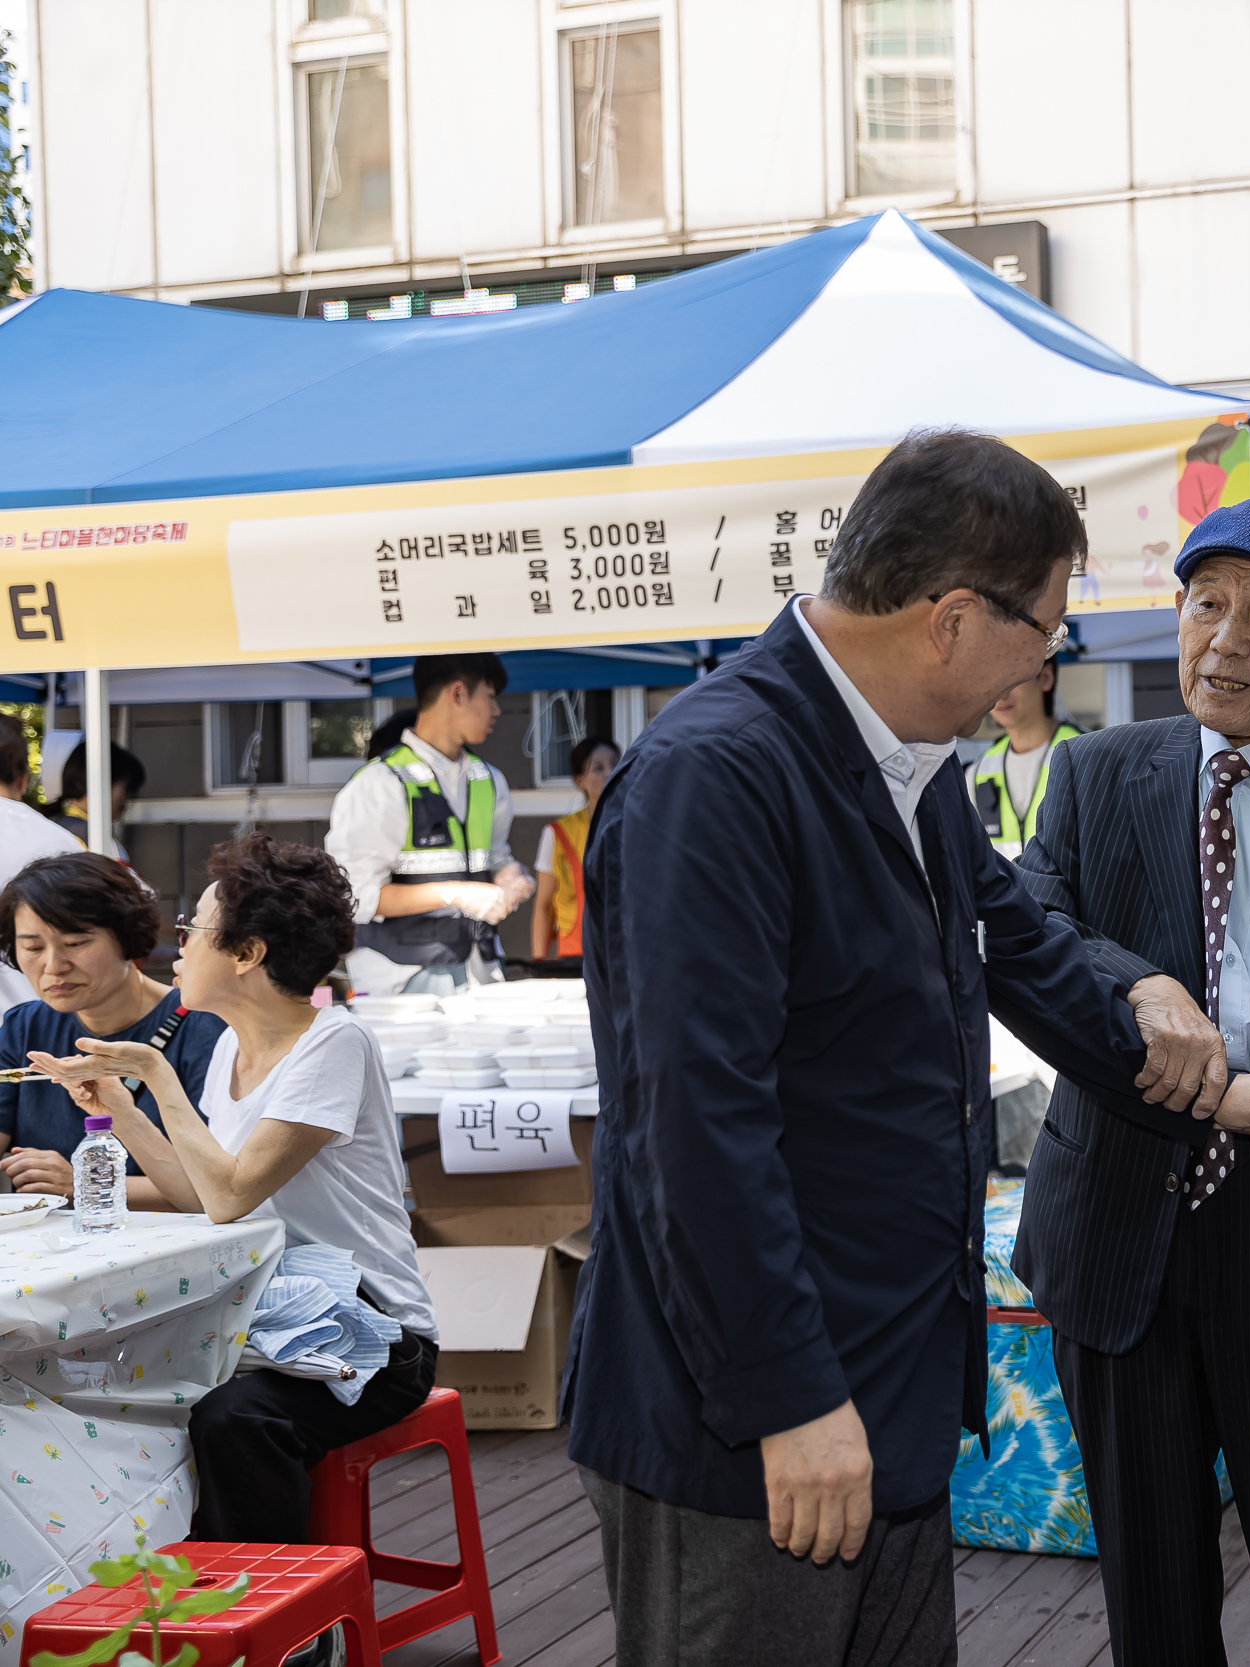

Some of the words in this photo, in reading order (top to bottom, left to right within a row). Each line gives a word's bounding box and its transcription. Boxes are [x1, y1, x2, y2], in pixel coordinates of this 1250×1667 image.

[376, 529, 544, 562] 소머리국밥세트
[564, 520, 666, 551] 5,000원
[776, 510, 798, 535] 홍
[820, 507, 842, 530] 어
[379, 569, 399, 592] 편
[529, 559, 549, 582] 육
[570, 551, 671, 582] 3,000원
[9, 581, 64, 641] 터
[382, 599, 403, 623] 컵
[455, 594, 478, 618] 과
[530, 590, 552, 614] 일
[571, 582, 675, 614] 2,000원
[455, 1098, 554, 1153] 편육
